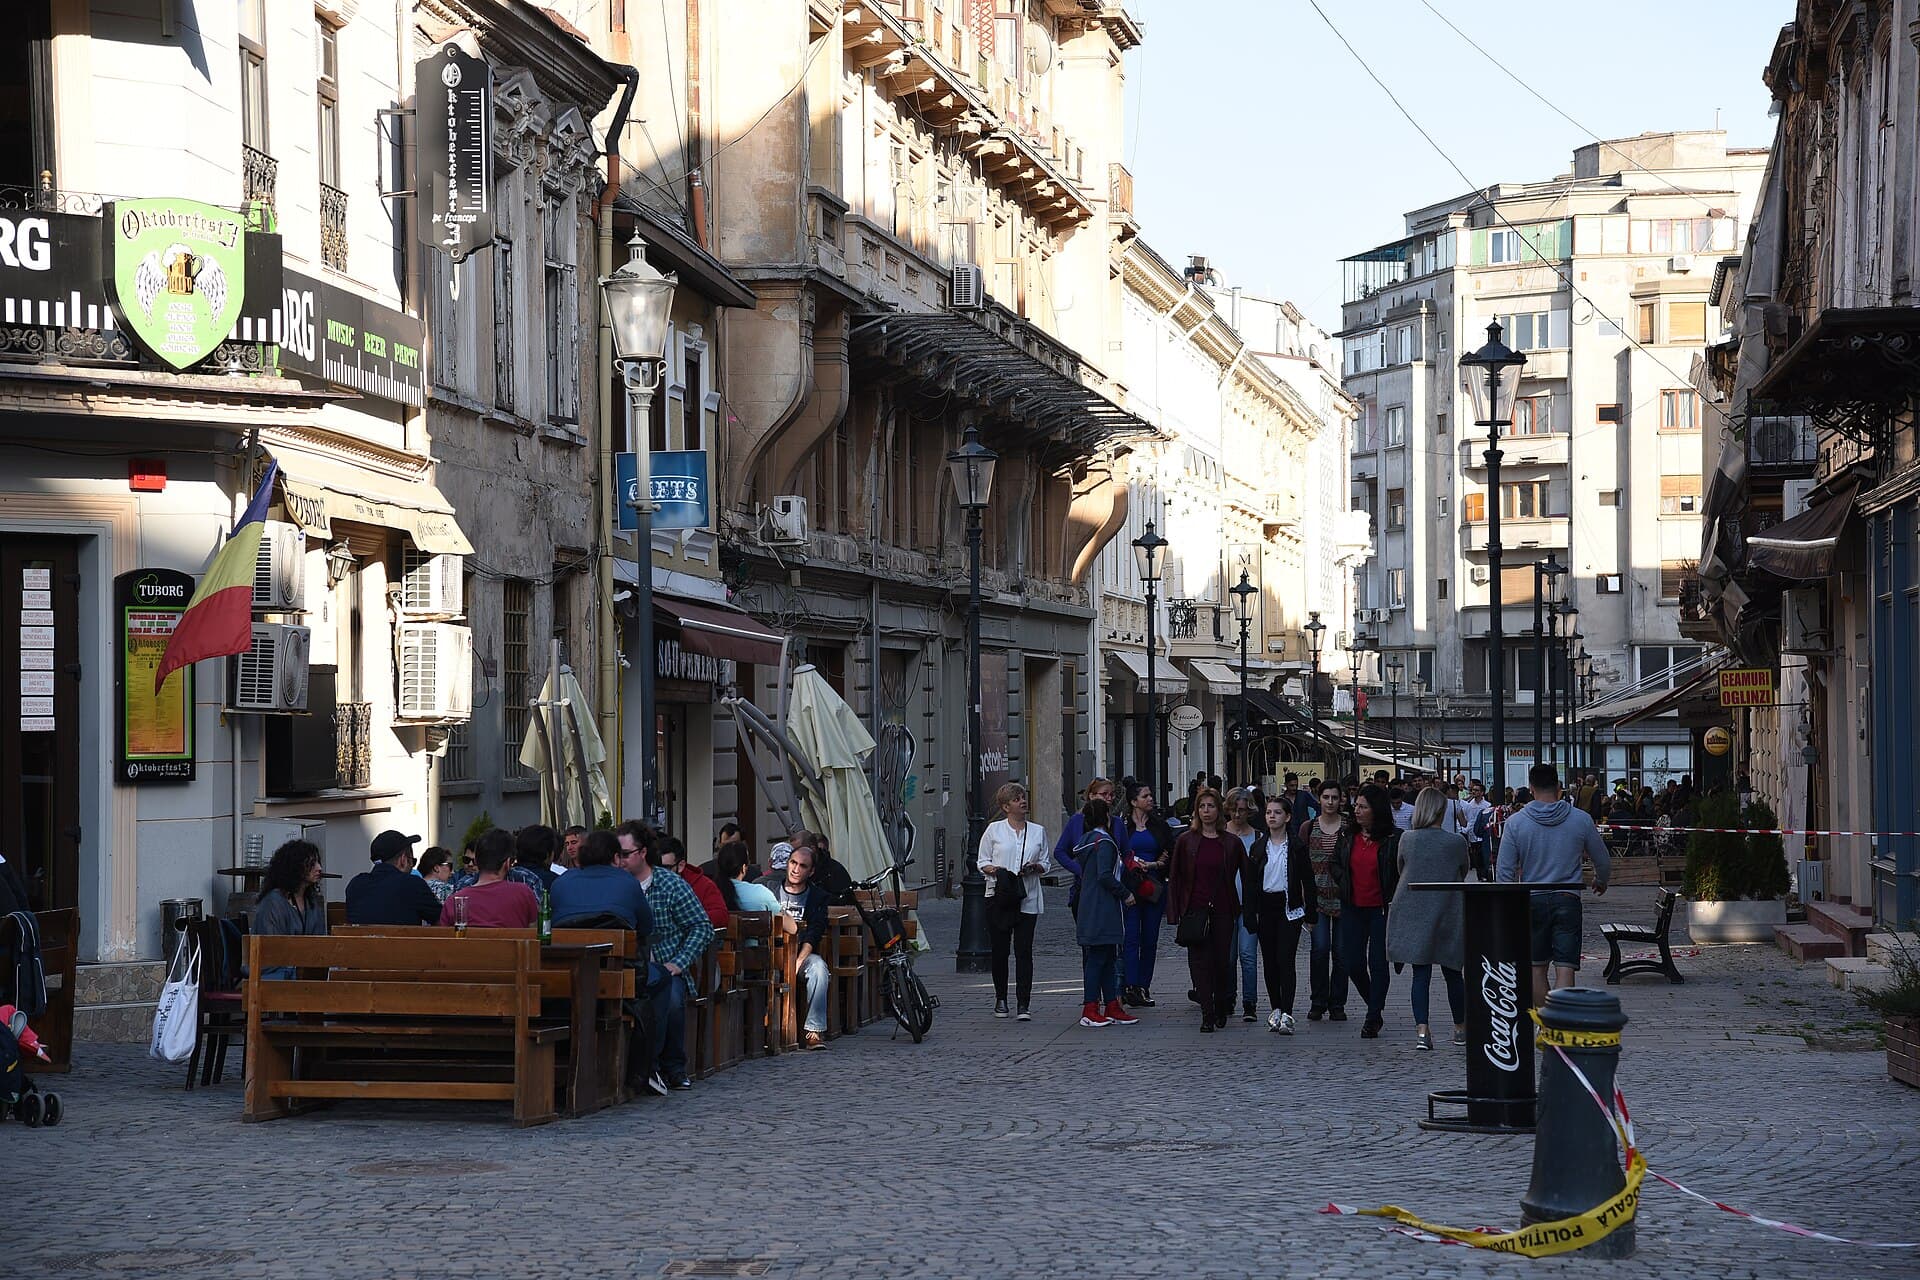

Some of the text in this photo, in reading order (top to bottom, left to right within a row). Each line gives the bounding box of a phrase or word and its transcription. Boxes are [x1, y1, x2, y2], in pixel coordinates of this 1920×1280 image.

[442, 62, 463, 212] Oktoberfest
[327, 319, 418, 369] MUSIC BEER PARTY
[287, 491, 327, 530] TUBORG
[140, 584, 184, 597] TUBORG
[1721, 671, 1770, 688] GEAMURI
[1722, 689, 1771, 705] OGLINZI
[1481, 954, 1520, 1072] Coca-Cola
[1596, 1186, 1641, 1229] OCALĂ
